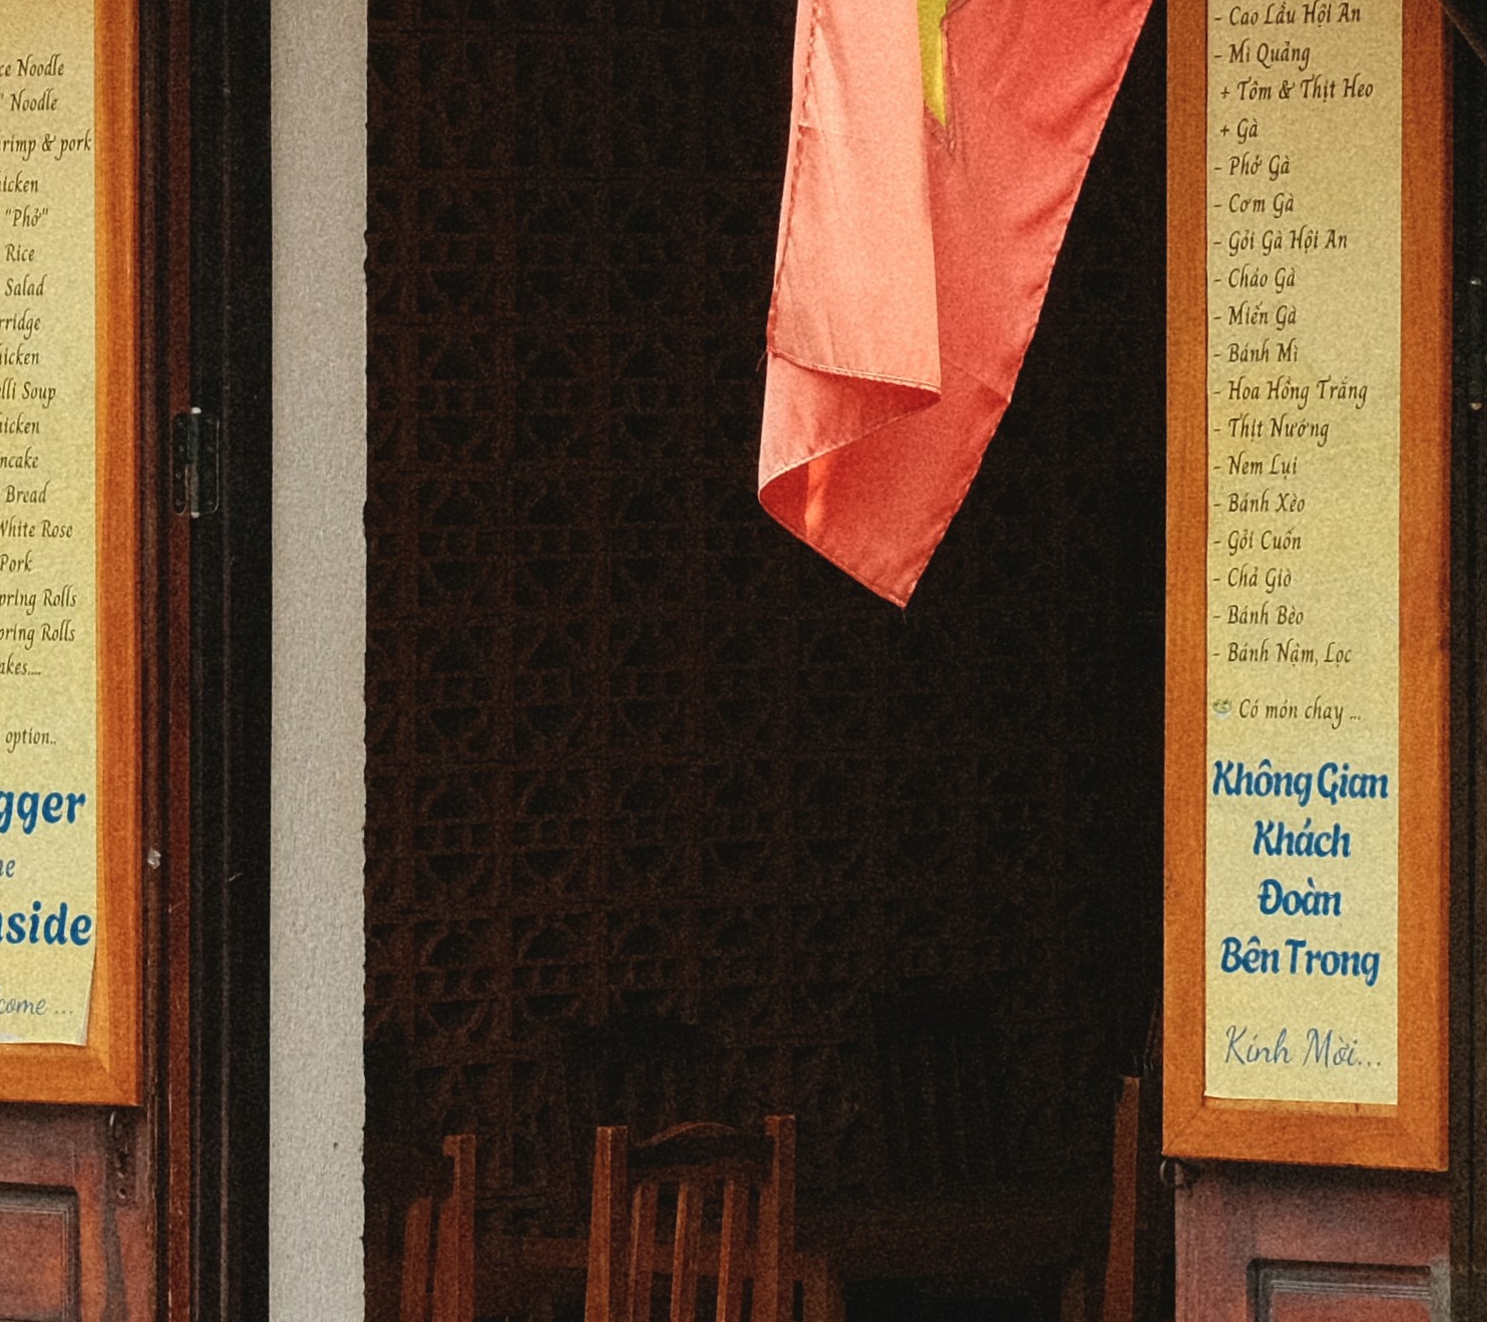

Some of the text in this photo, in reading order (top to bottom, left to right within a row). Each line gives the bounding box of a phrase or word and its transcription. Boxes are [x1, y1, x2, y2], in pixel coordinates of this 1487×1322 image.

[1229, 0, 1361, 27] Cao Lầu Hội An
[17, 54, 64, 77] Noodle
[1257, 41, 1311, 71] Quảng
[10, 88, 58, 112] Noodle
[1237, 73, 1373, 103] Tôm & Thịt Heo
[41, 133, 57, 152] &
[55, 129, 92, 160] pork
[1237, 118, 1258, 144] Gà
[1269, 155, 1290, 181] Gà
[1229, 192, 1294, 218] Cơm Gà
[5, 243, 35, 262] Rice
[1229, 224, 1347, 256] Gỏi Gà Hội An
[4, 274, 48, 297] Salad
[1274, 267, 1296, 294] Gà
[1228, 300, 1296, 331] Miến Gà
[1228, 338, 1298, 363] Bánh Mì
[22, 381, 56, 409] Soup
[1228, 376, 1259, 400] Hoa
[1267, 375, 1309, 410] Hồng
[1228, 412, 1329, 447] Thịt Nướng
[1228, 450, 1297, 479] Nem Lụi
[5, 480, 50, 503] Bread
[1228, 488, 1305, 512] Bánh Xèo
[41, 519, 73, 538] Rose
[1228, 528, 1302, 556] Gỏi Cuốn
[0, 550, 32, 572] Pork
[1228, 563, 1292, 594] Chả Giò
[43, 584, 77, 607] Rolls
[1227, 601, 1304, 625] Bánh Bèo
[41, 619, 75, 642] Rolls
[1227, 638, 1269, 662] Bánh
[1324, 642, 1352, 667] Lọc
[1239, 699, 1258, 719] Có
[1265, 699, 1298, 719] món
[1305, 696, 1343, 730] chay
[1212, 758, 1388, 808] Không Gian
[1253, 817, 1351, 858] Khách
[1257, 876, 1342, 917] Đoàn
[1220, 936, 1381, 987] Bên Trong
[1225, 1025, 1292, 1065] Kính
